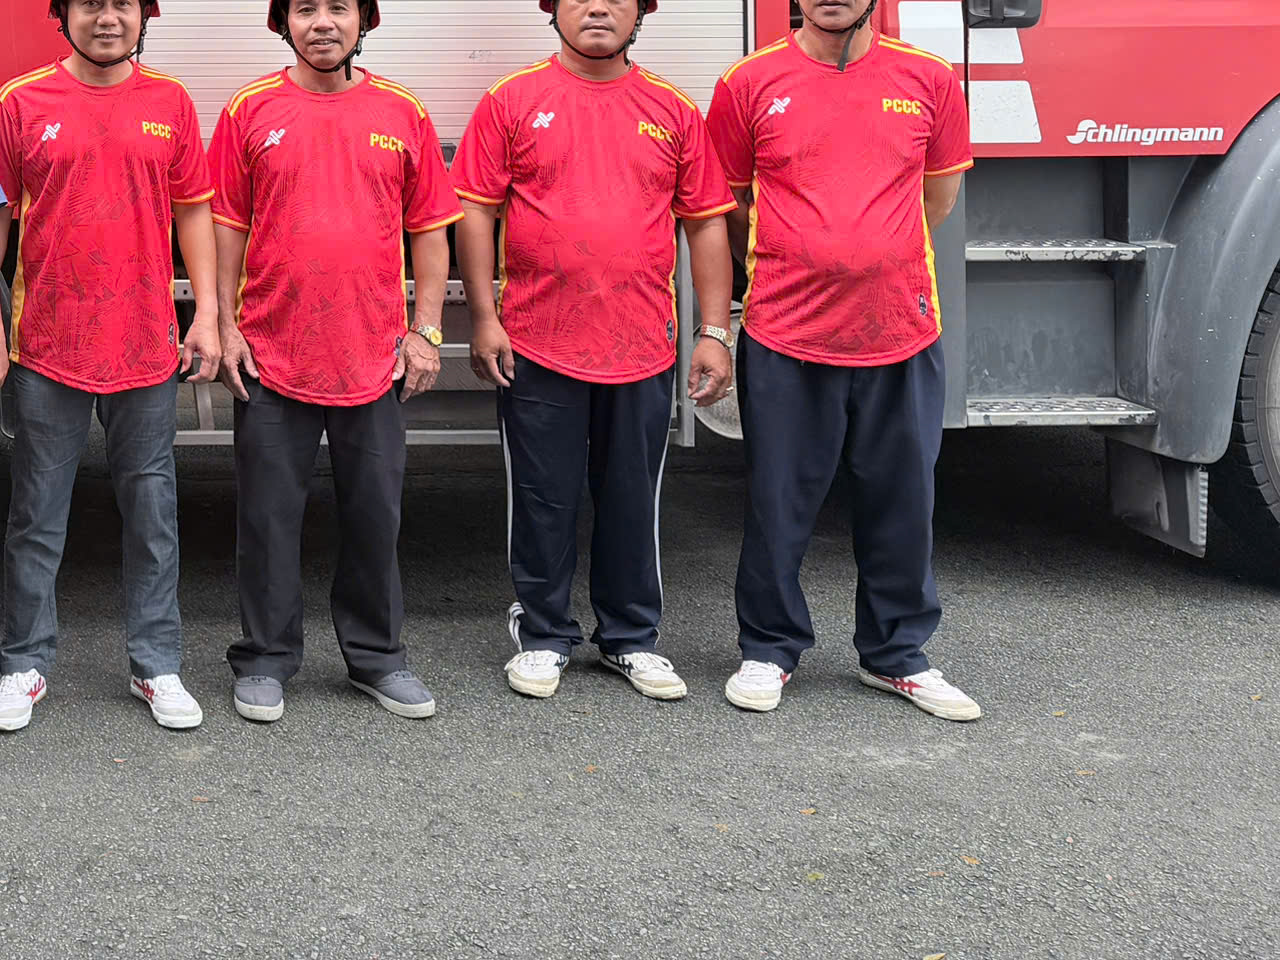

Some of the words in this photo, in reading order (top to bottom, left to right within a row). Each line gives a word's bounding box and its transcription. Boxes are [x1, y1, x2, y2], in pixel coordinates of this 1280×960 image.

[882, 98, 921, 115] PCCC
[142, 120, 171, 139] PCCC
[1065, 119, 1224, 146] Schlingmann
